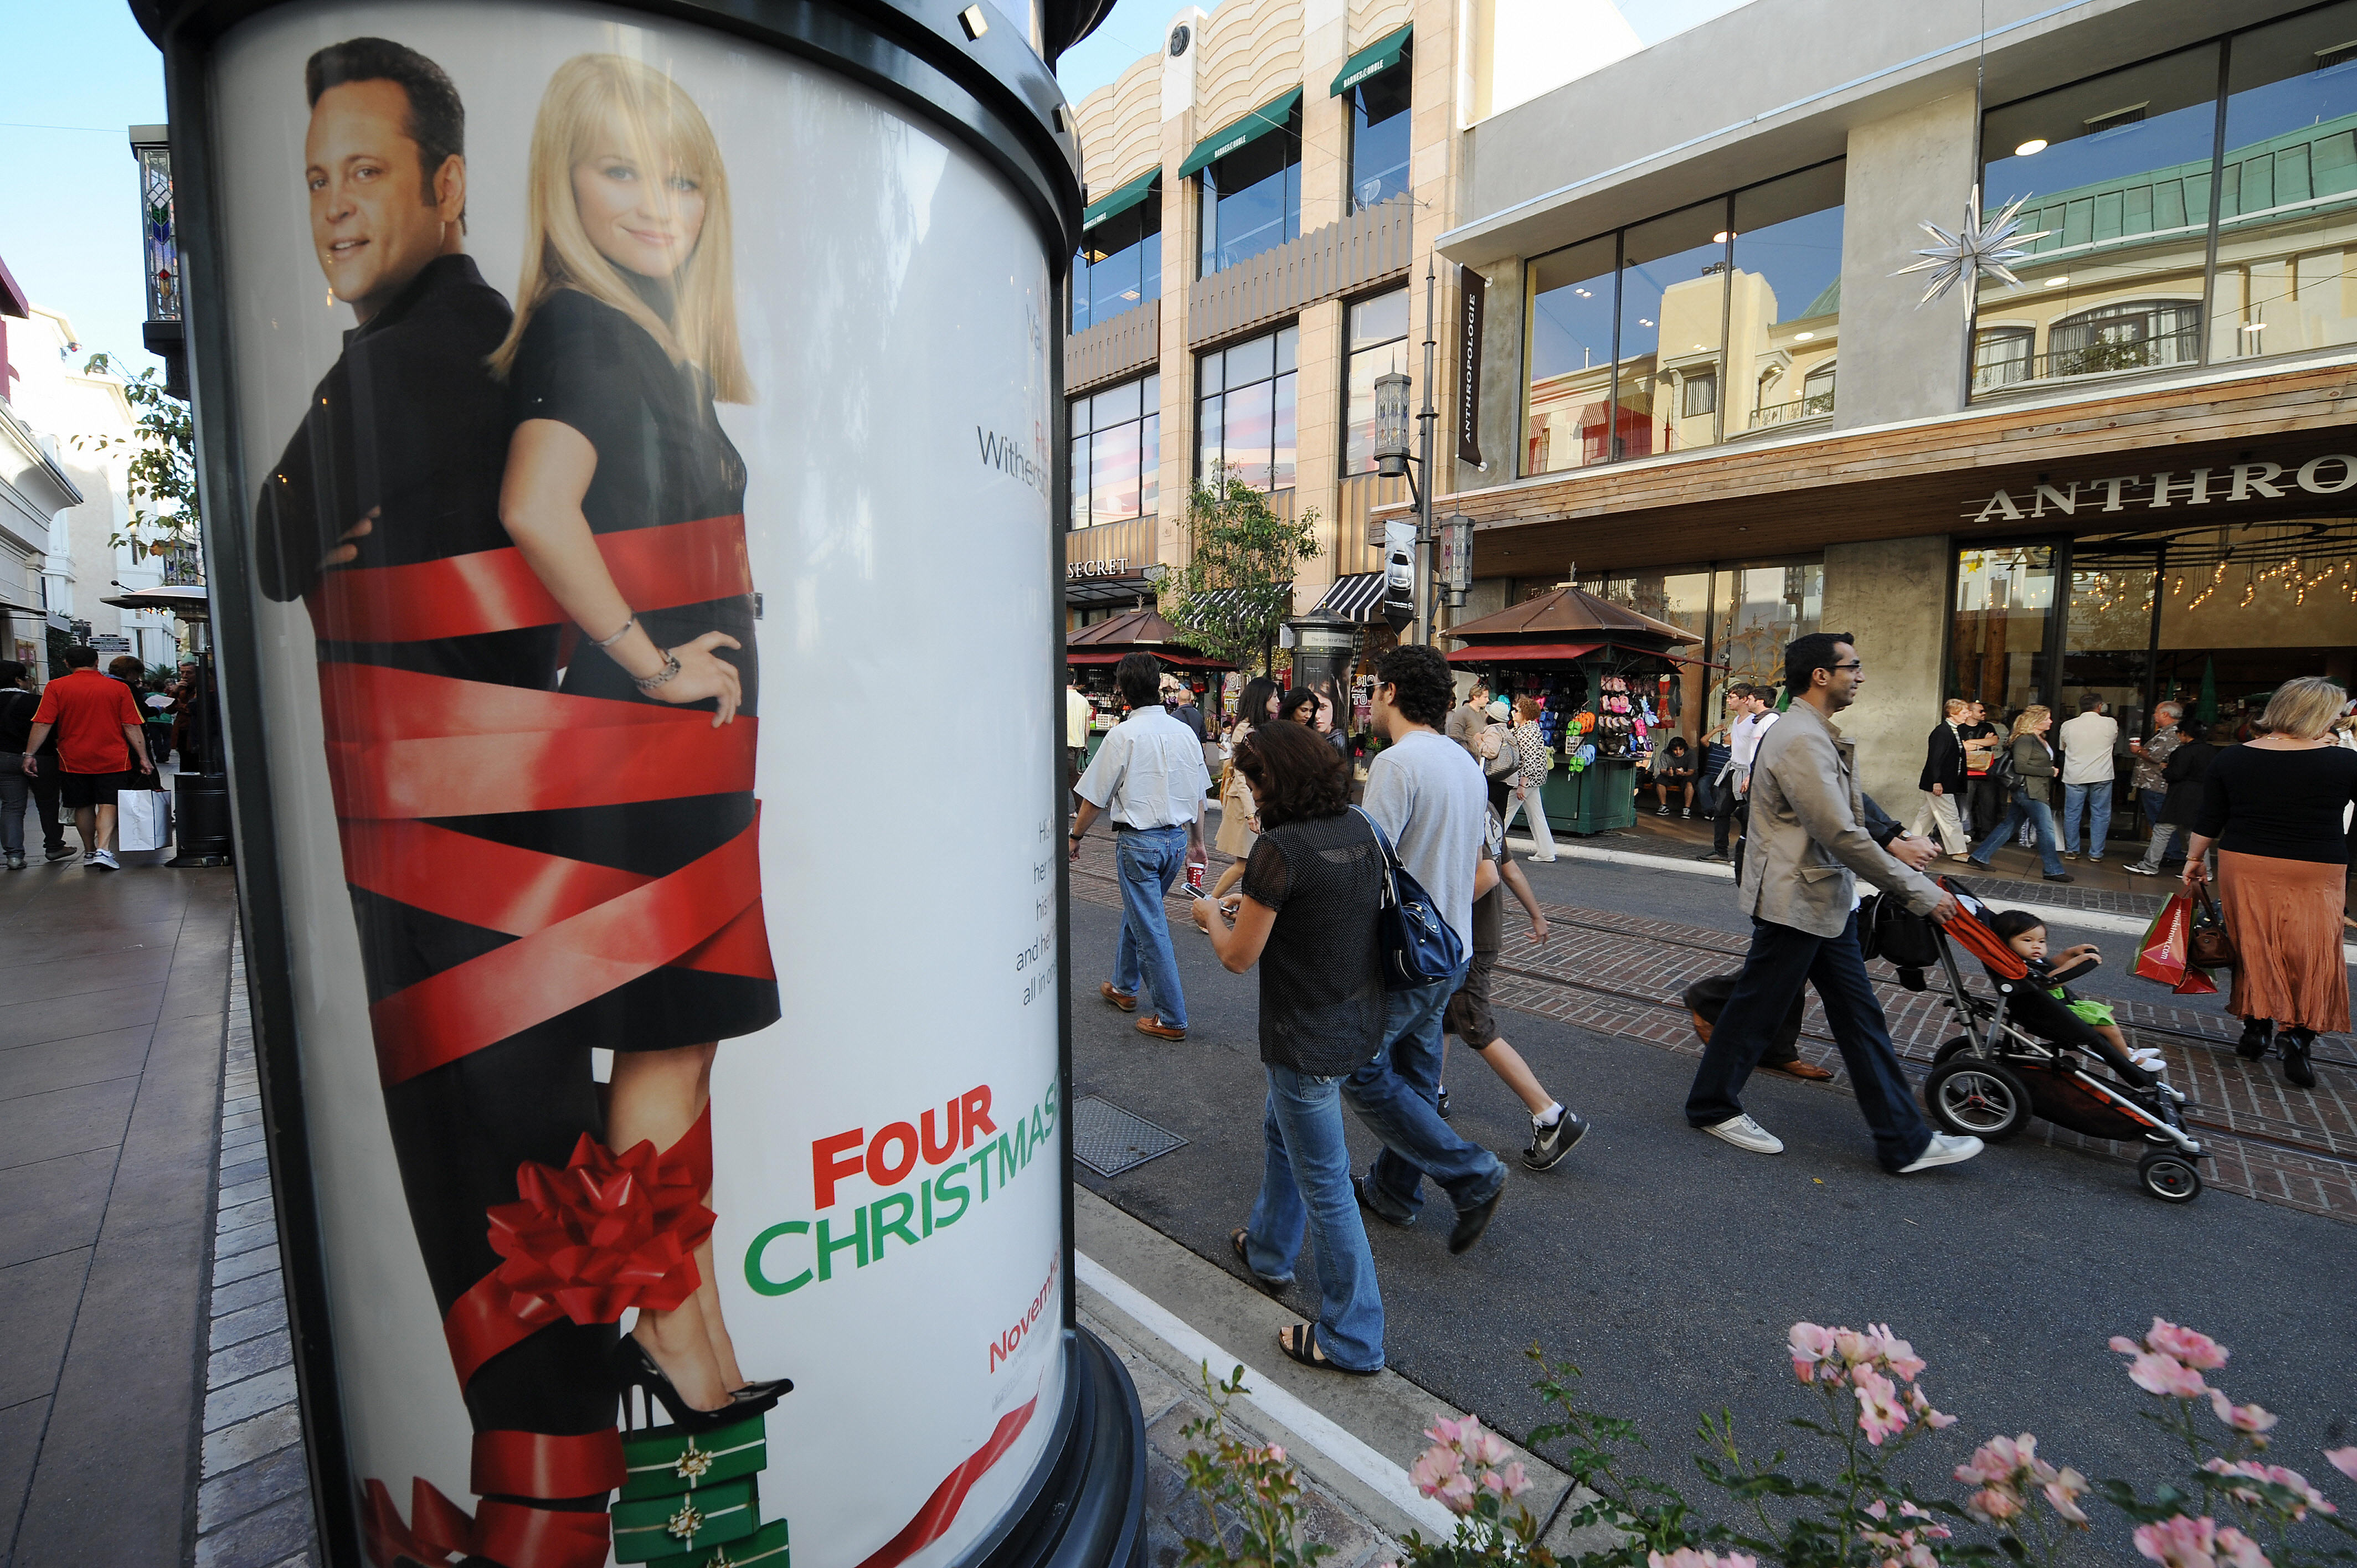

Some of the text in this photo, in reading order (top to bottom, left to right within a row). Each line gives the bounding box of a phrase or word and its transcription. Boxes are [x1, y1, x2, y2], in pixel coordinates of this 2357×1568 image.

[1465, 293, 1476, 443] ANTHROPOLOGIE
[1068, 558, 1129, 578] SECRET
[1016, 936, 1038, 972] and
[2160, 909, 2181, 960] nordstrom.com
[1023, 976, 1036, 1006] all
[1038, 972, 1045, 995] in
[812, 1084, 997, 1211] FOUR
[744, 1077, 1057, 1297] CHRISTMAS
